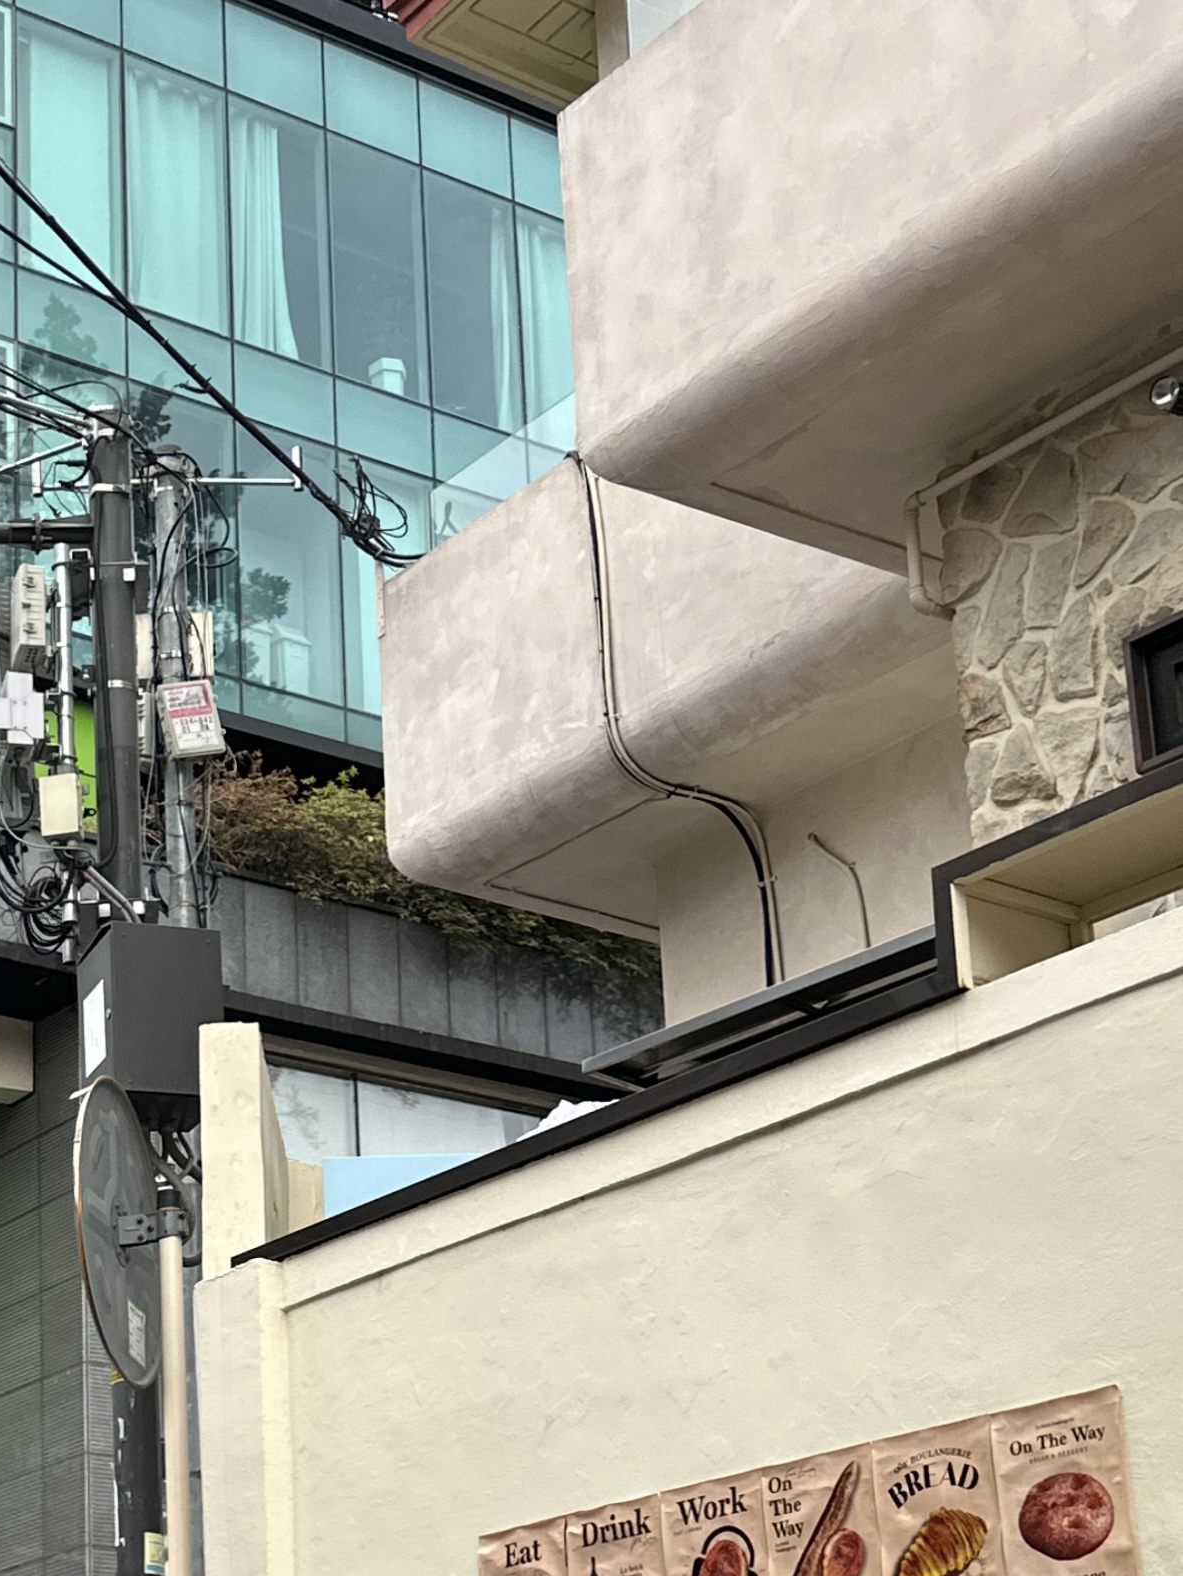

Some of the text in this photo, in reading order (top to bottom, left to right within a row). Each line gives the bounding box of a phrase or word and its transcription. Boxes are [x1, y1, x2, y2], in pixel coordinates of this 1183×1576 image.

[1009, 1440, 1033, 1456] On
[1036, 1433, 1067, 1450] The
[1071, 1424, 1106, 1443] Way
[768, 1476, 793, 1494] On
[887, 1461, 979, 1509] BREAD
[677, 1486, 748, 1526] Work
[769, 1498, 802, 1517] The
[581, 1508, 652, 1548] Drink
[772, 1520, 805, 1539] Way
[504, 1540, 542, 1568] Eat
